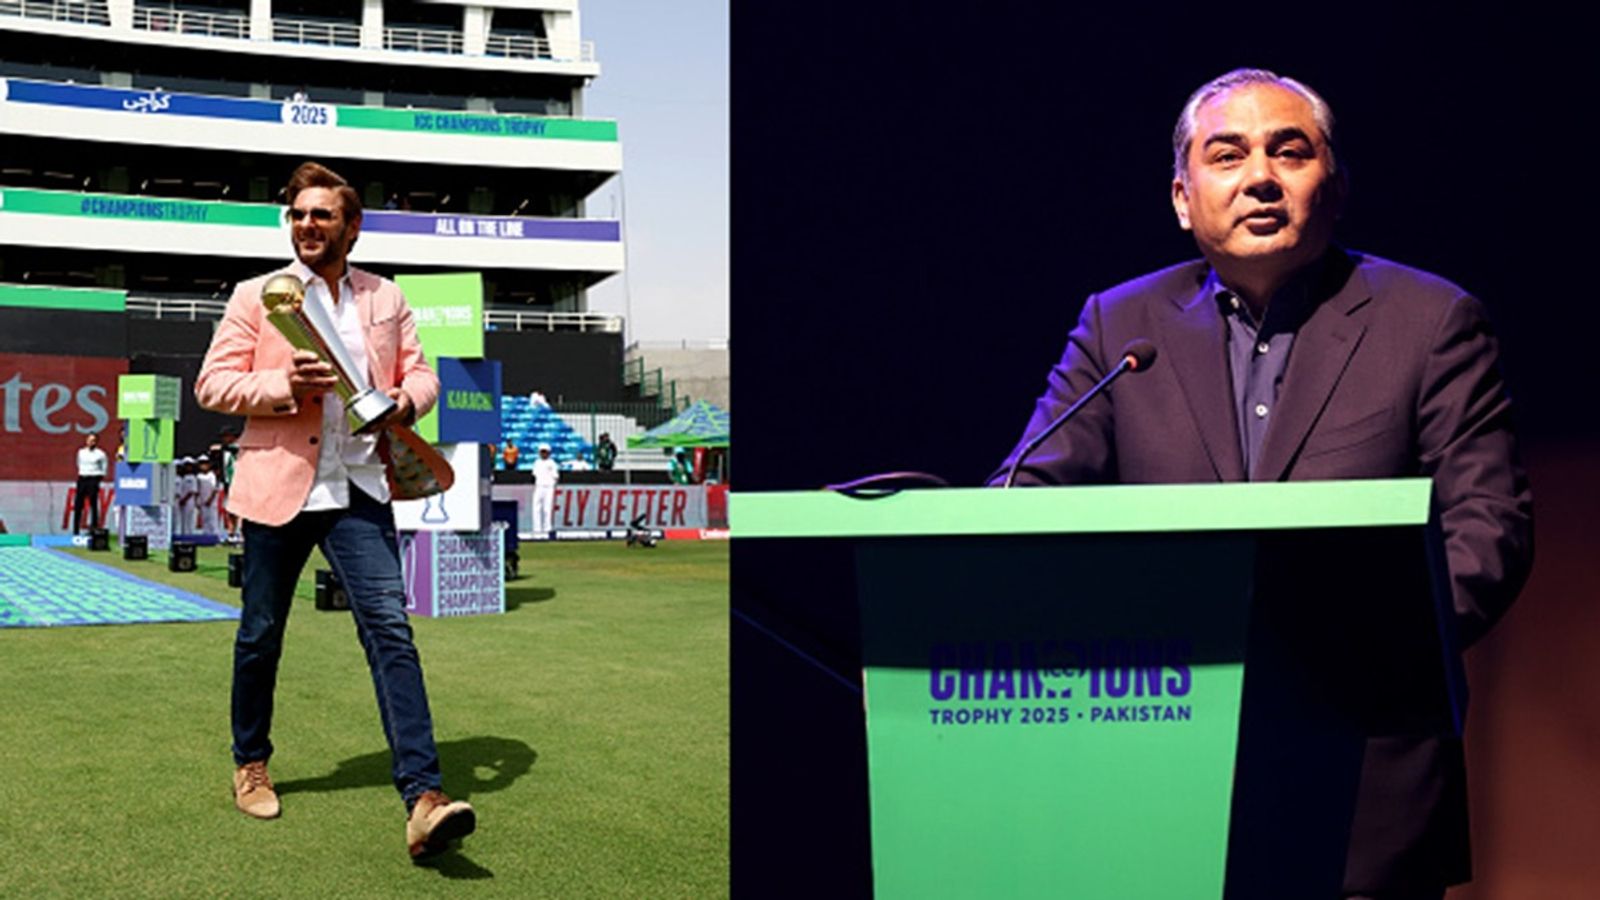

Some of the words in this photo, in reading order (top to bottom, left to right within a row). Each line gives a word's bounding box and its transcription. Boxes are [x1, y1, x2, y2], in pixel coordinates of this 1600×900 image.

[123, 93, 171, 113] کراچی
[291, 105, 328, 125] 2025
[414, 114, 433, 130] ICC
[436, 115, 501, 133] CHAMPIONS
[504, 118, 547, 135] TROPHY
[436, 218, 457, 235] ALL
[459, 219, 475, 235] ON
[478, 220, 498, 237] THE
[500, 221, 525, 238] LINE
[551, 489, 590, 527] FLY
[598, 489, 688, 527] BETTER
[930, 638, 1192, 701] CHAMIONS
[930, 707, 1012, 726] TROPHY
[1020, 706, 1070, 725] 2025
[1090, 704, 1193, 723] PAKISTAN
